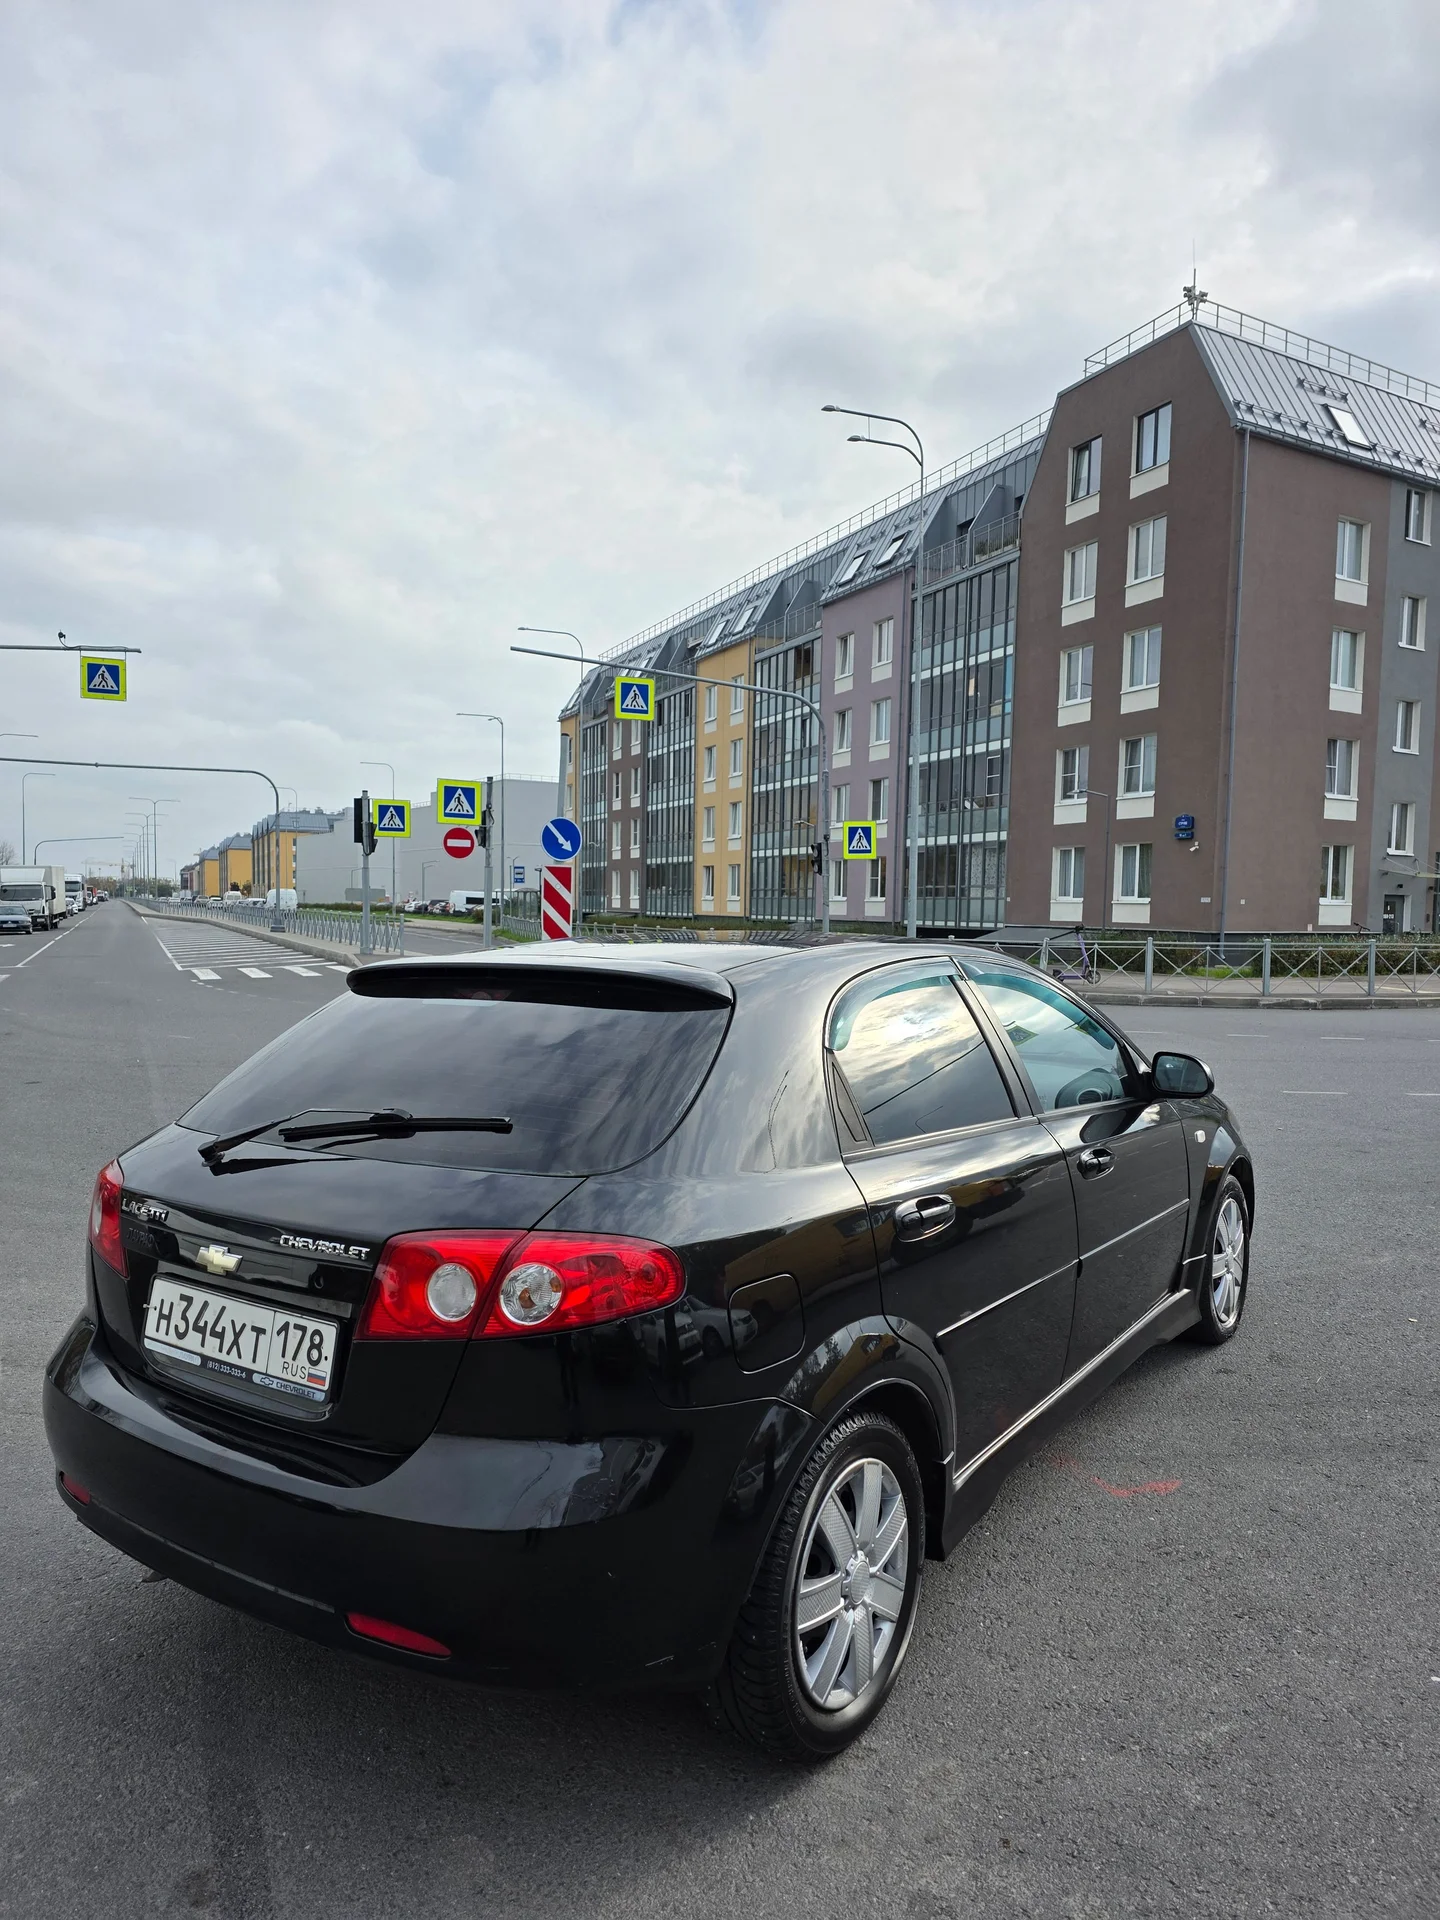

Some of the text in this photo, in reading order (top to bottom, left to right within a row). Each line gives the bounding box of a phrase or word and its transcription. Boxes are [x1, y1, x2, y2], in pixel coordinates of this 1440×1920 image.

[279, 1235, 371, 1260] CHEVROLET
[155, 1293, 324, 1367] Н344ХТ 178
[282, 1361, 307, 1380] RUS
[275, 1381, 317, 1399] CHEVROLET
